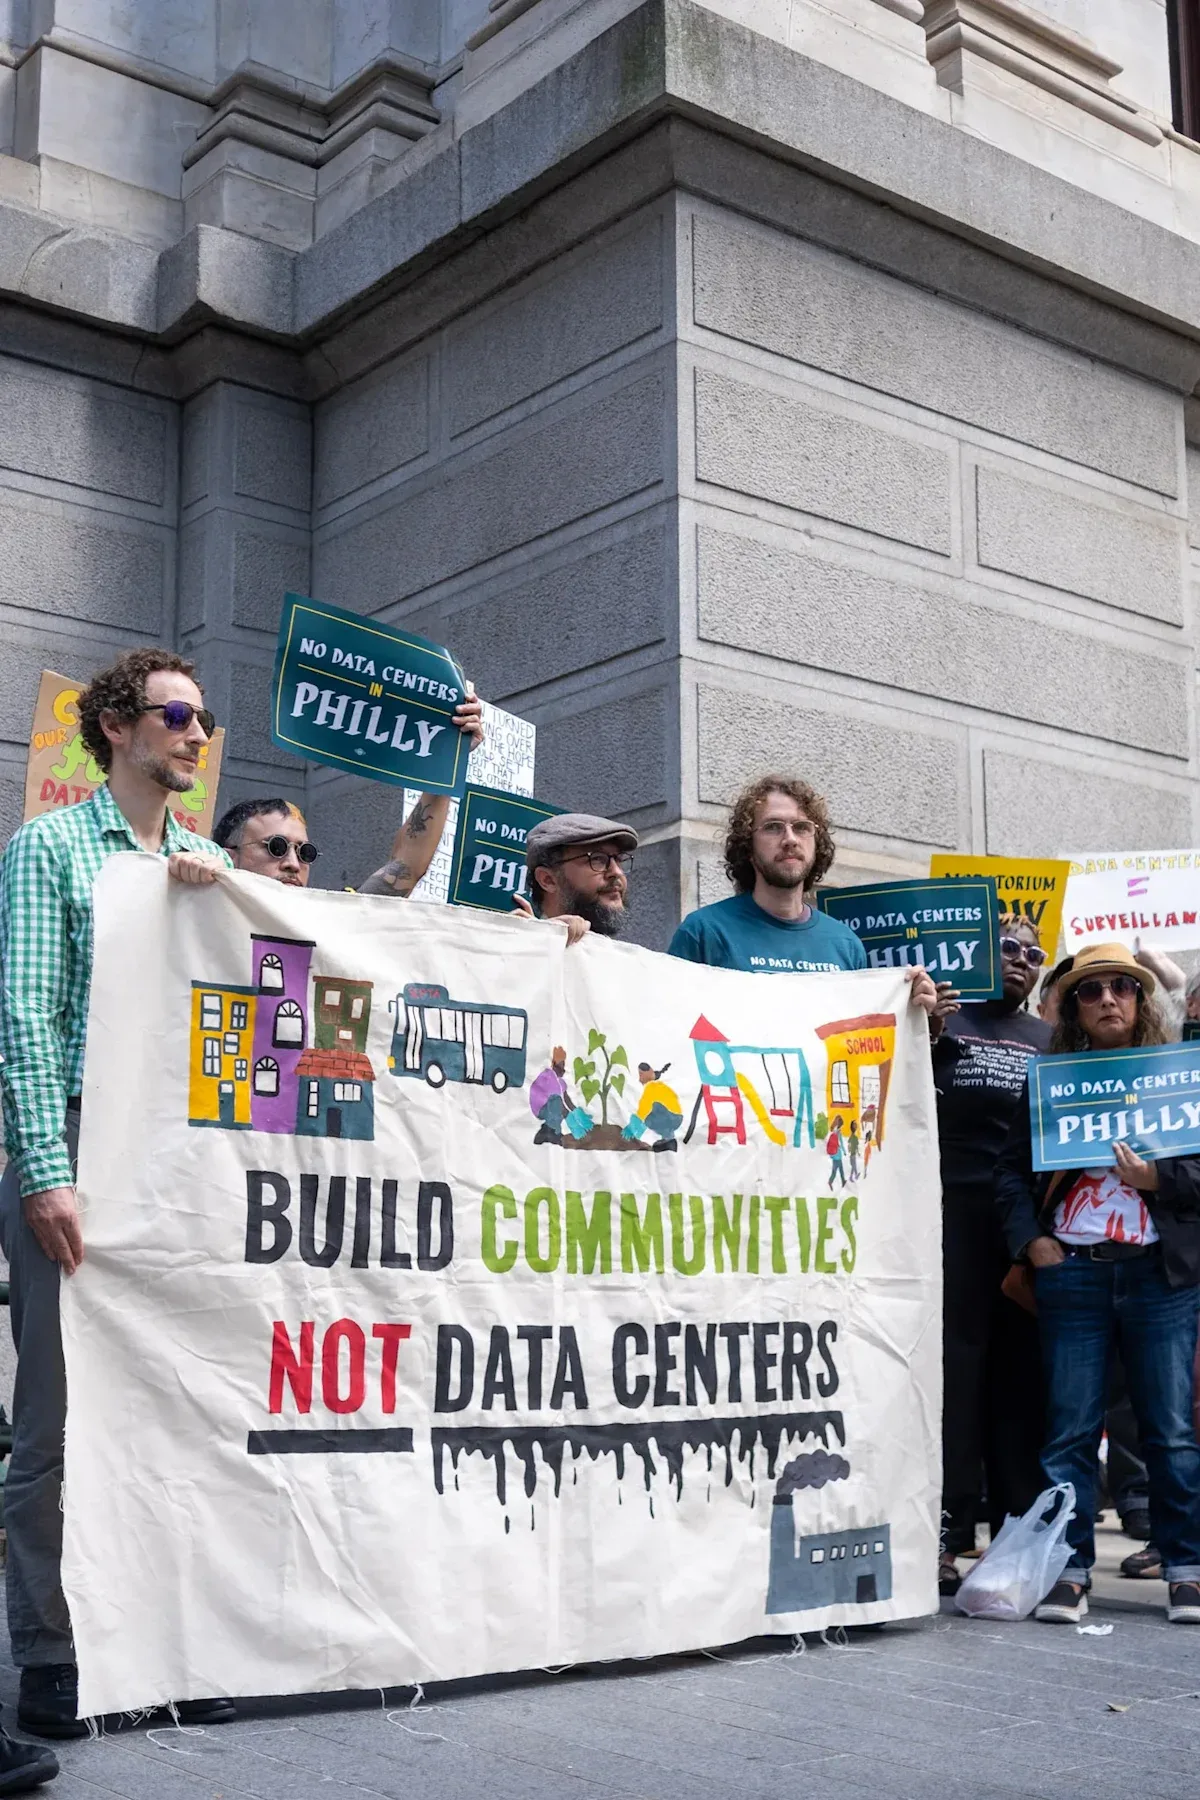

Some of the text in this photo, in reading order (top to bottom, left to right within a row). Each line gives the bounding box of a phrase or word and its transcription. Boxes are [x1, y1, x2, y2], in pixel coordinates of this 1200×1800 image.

[300, 637, 460, 703] NO DATA CENTERS
[369, 681, 384, 699] IN
[289, 681, 447, 758] PHILLY
[489, 705, 534, 740] TURNED
[33, 727, 69, 750] OUR
[481, 720, 534, 756] ING OVER
[471, 753, 515, 781] BUT THAT
[500, 755, 521, 774] SET
[508, 744, 534, 770] HOPE
[468, 763, 483, 778] TED
[487, 773, 513, 791] OTHER
[474, 817, 527, 844] NO DAT
[469, 853, 532, 897] PHI
[1068, 857, 1118, 876] DATA
[866, 912, 907, 930] DATA
[912, 907, 982, 923] CENTERS
[1070, 911, 1200, 935] SURVEILLAN
[905, 927, 918, 939] IN
[749, 956, 841, 973] NO DATA CENTERS
[867, 940, 980, 973] HILLY
[846, 1036, 886, 1055] SCHOOL
[952, 1077, 1024, 1091] Harm Reduc
[954, 1066, 986, 1076] Youth
[1050, 1069, 1200, 1099] NO DATA CENTER
[1125, 1093, 1139, 1105] IN
[1056, 1101, 1200, 1146] PHILLY
[244, 1169, 860, 1276] BUILD COMMUNITIES
[268, 1317, 839, 1415] NOT DATA CENTERS
